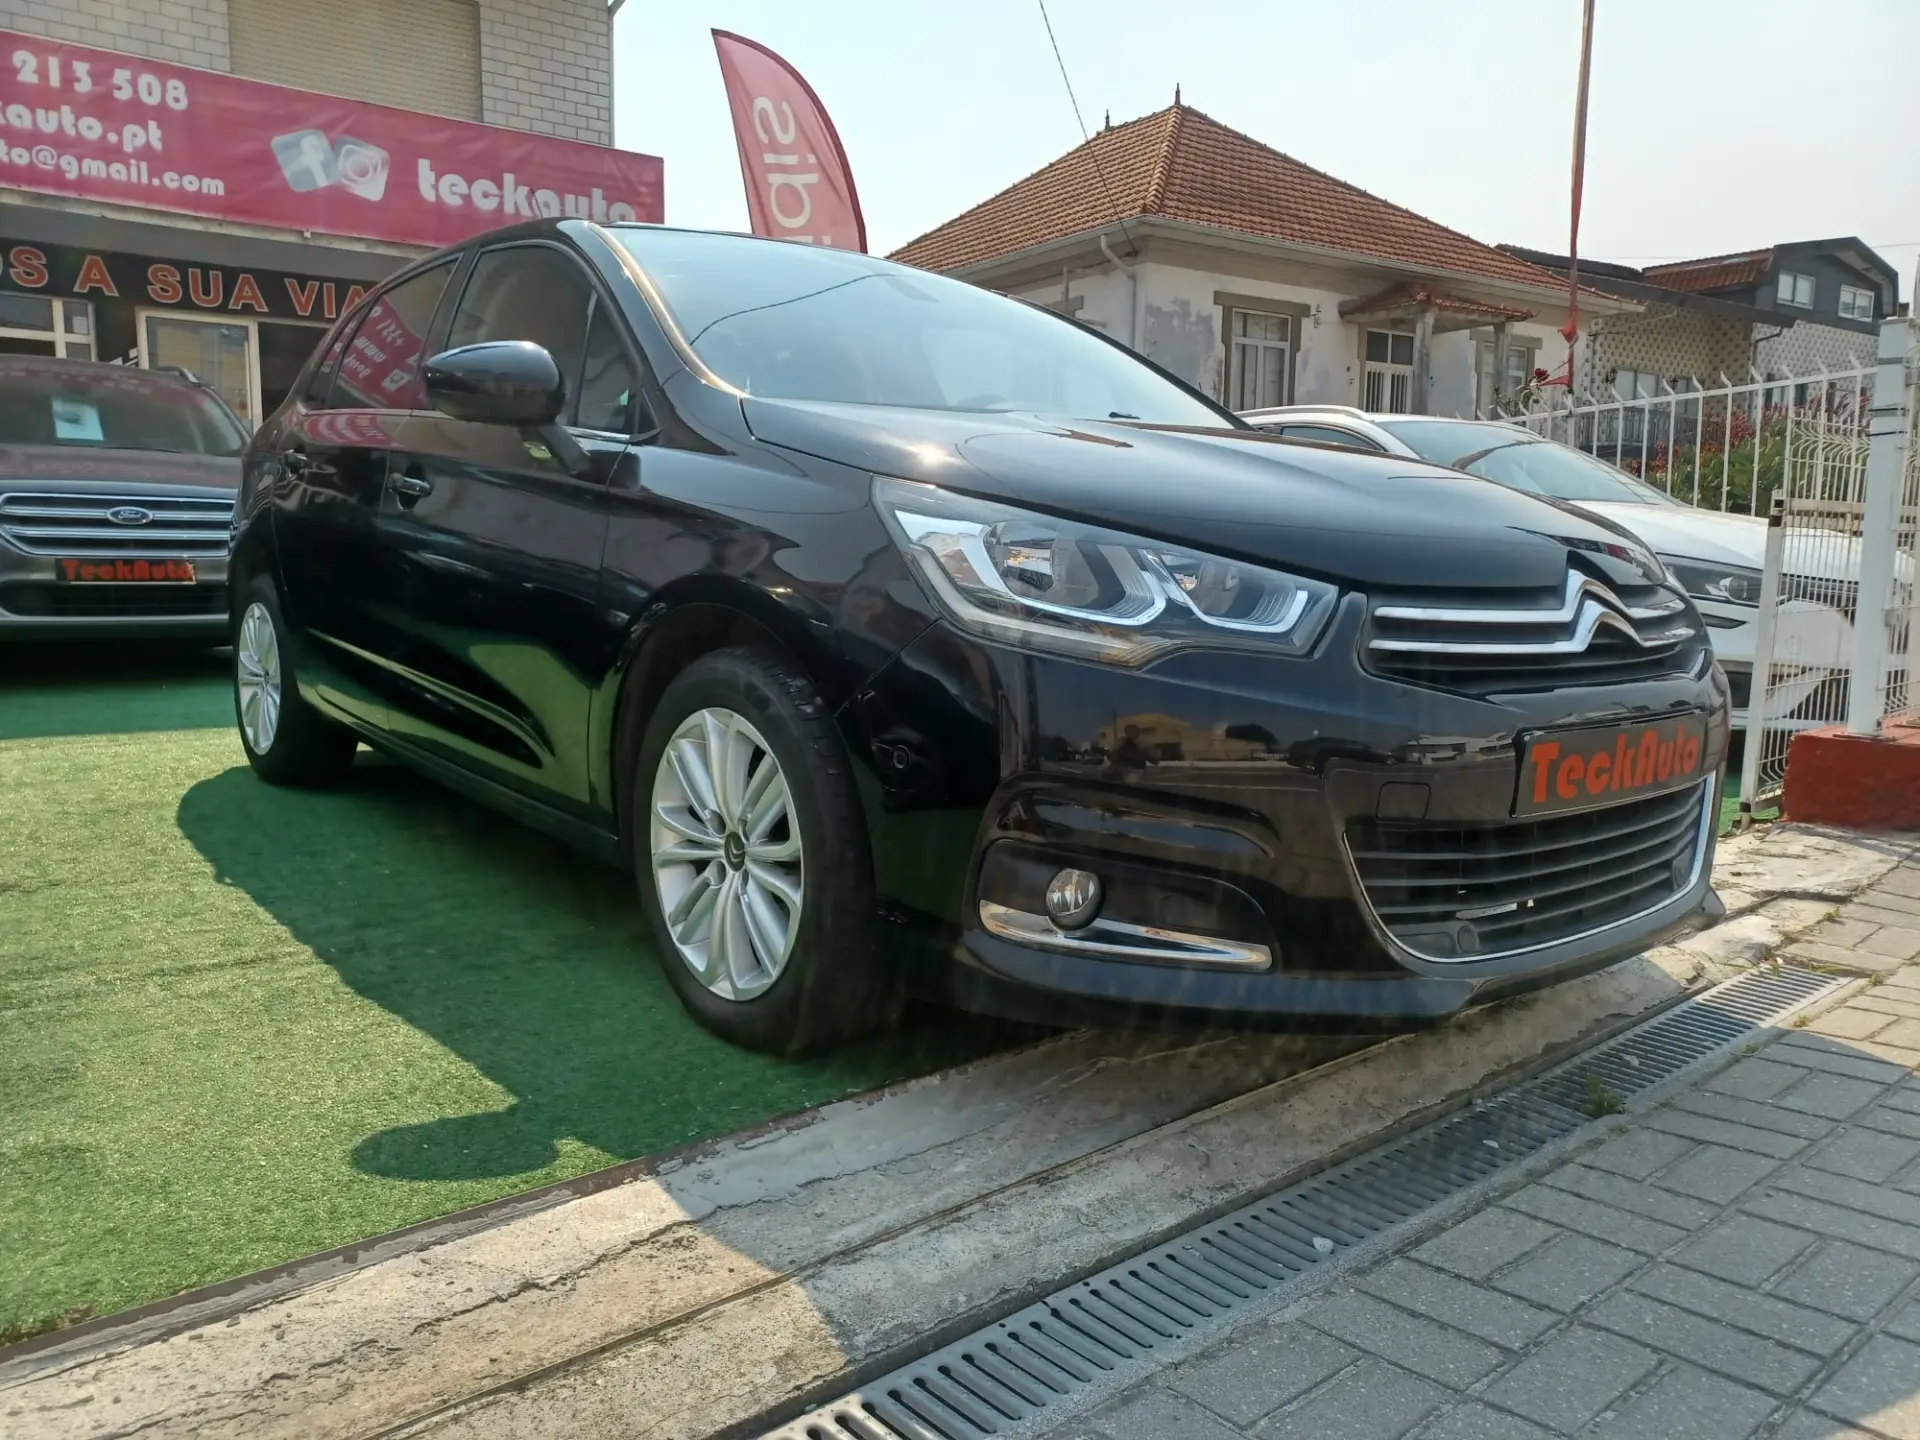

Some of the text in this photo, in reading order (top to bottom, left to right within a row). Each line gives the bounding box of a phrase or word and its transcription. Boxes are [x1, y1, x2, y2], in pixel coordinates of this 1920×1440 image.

[12, 50, 188, 111] 213 508
[0, 101, 163, 152] auto.pt
[417, 158, 637, 225] teckauto
[73, 254, 119, 297] A
[146, 264, 269, 312] SUA
[1530, 723, 1699, 804] TeckAuto
